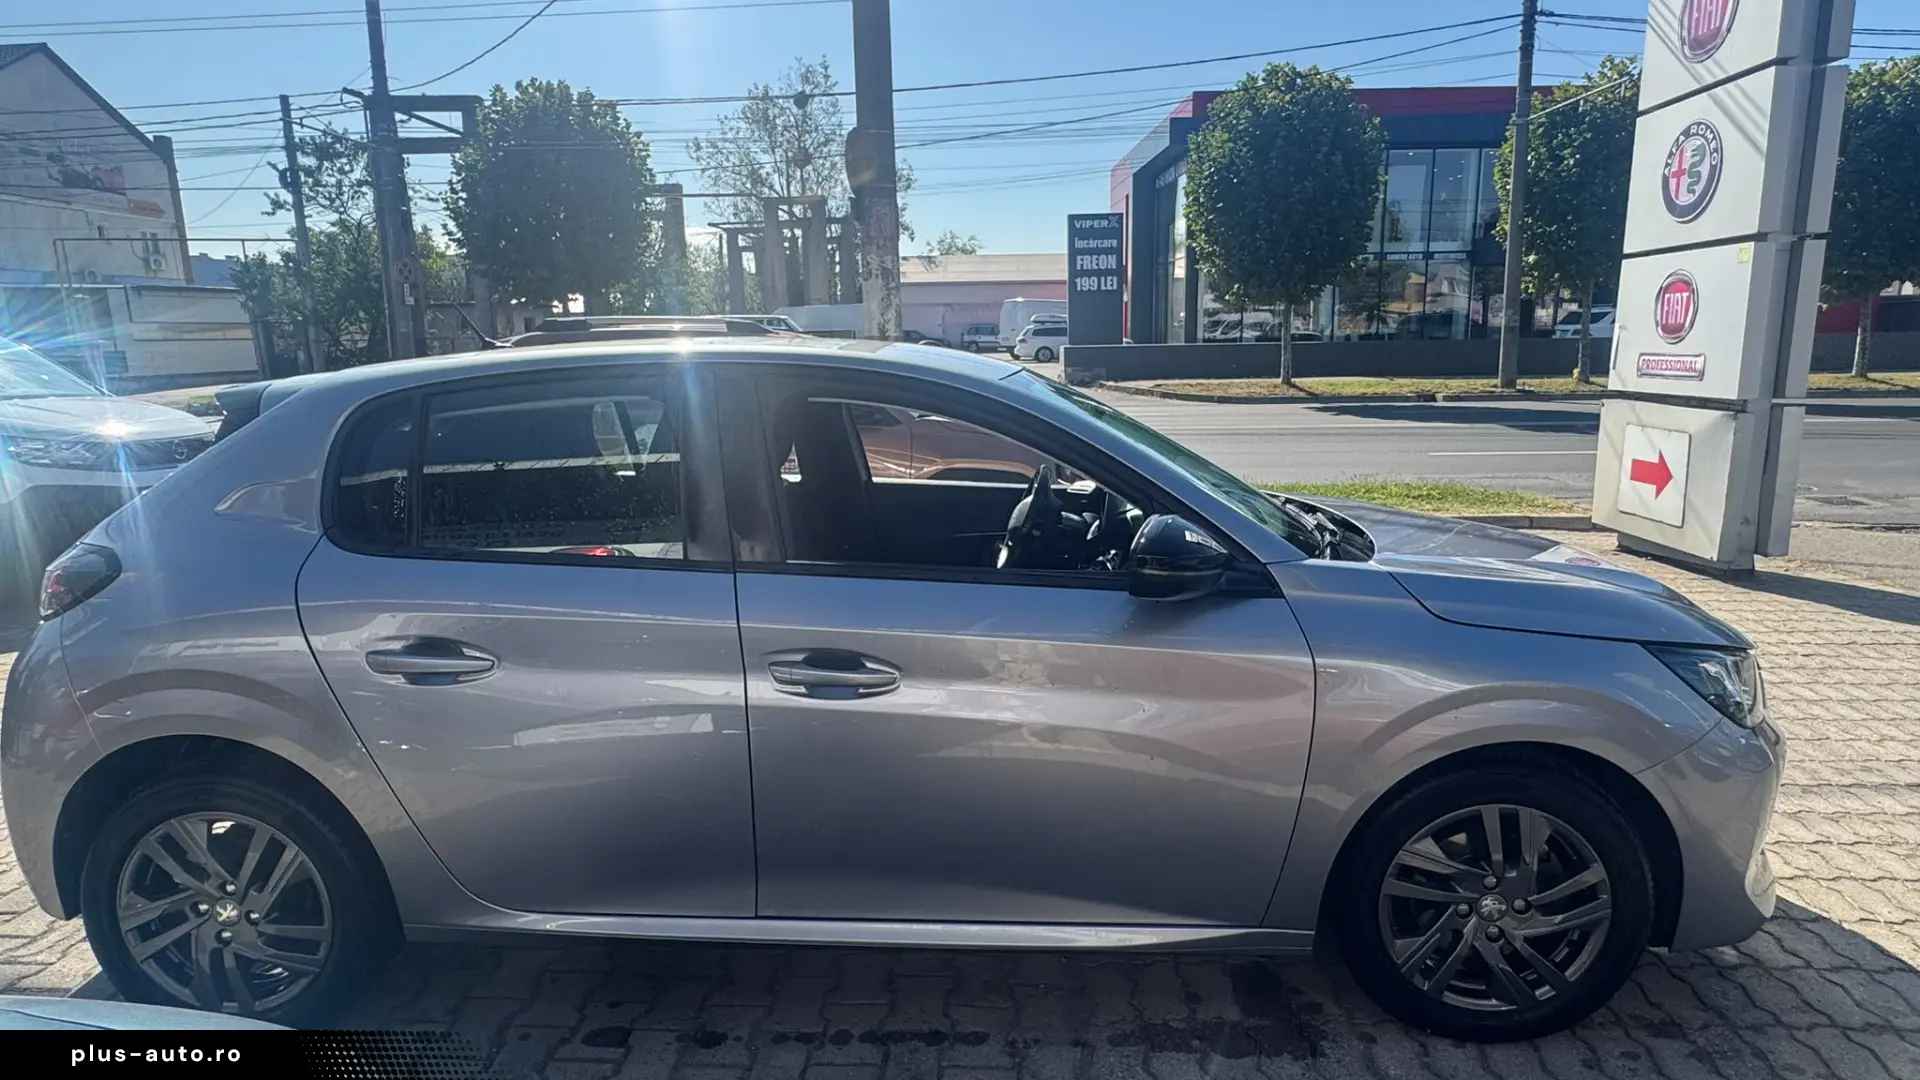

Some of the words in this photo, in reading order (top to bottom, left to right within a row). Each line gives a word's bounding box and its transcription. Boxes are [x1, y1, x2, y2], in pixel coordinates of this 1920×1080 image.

[1664, 135, 1686, 176] ALFA
[1690, 124, 1718, 165] ROMEO
[1076, 254, 1117, 270] FREON
[1075, 276, 1098, 291] 199
[1101, 276, 1117, 290] LEI
[1662, 292, 1690, 324] FIAT
[1641, 358, 1698, 373] PROFESSIONAL
